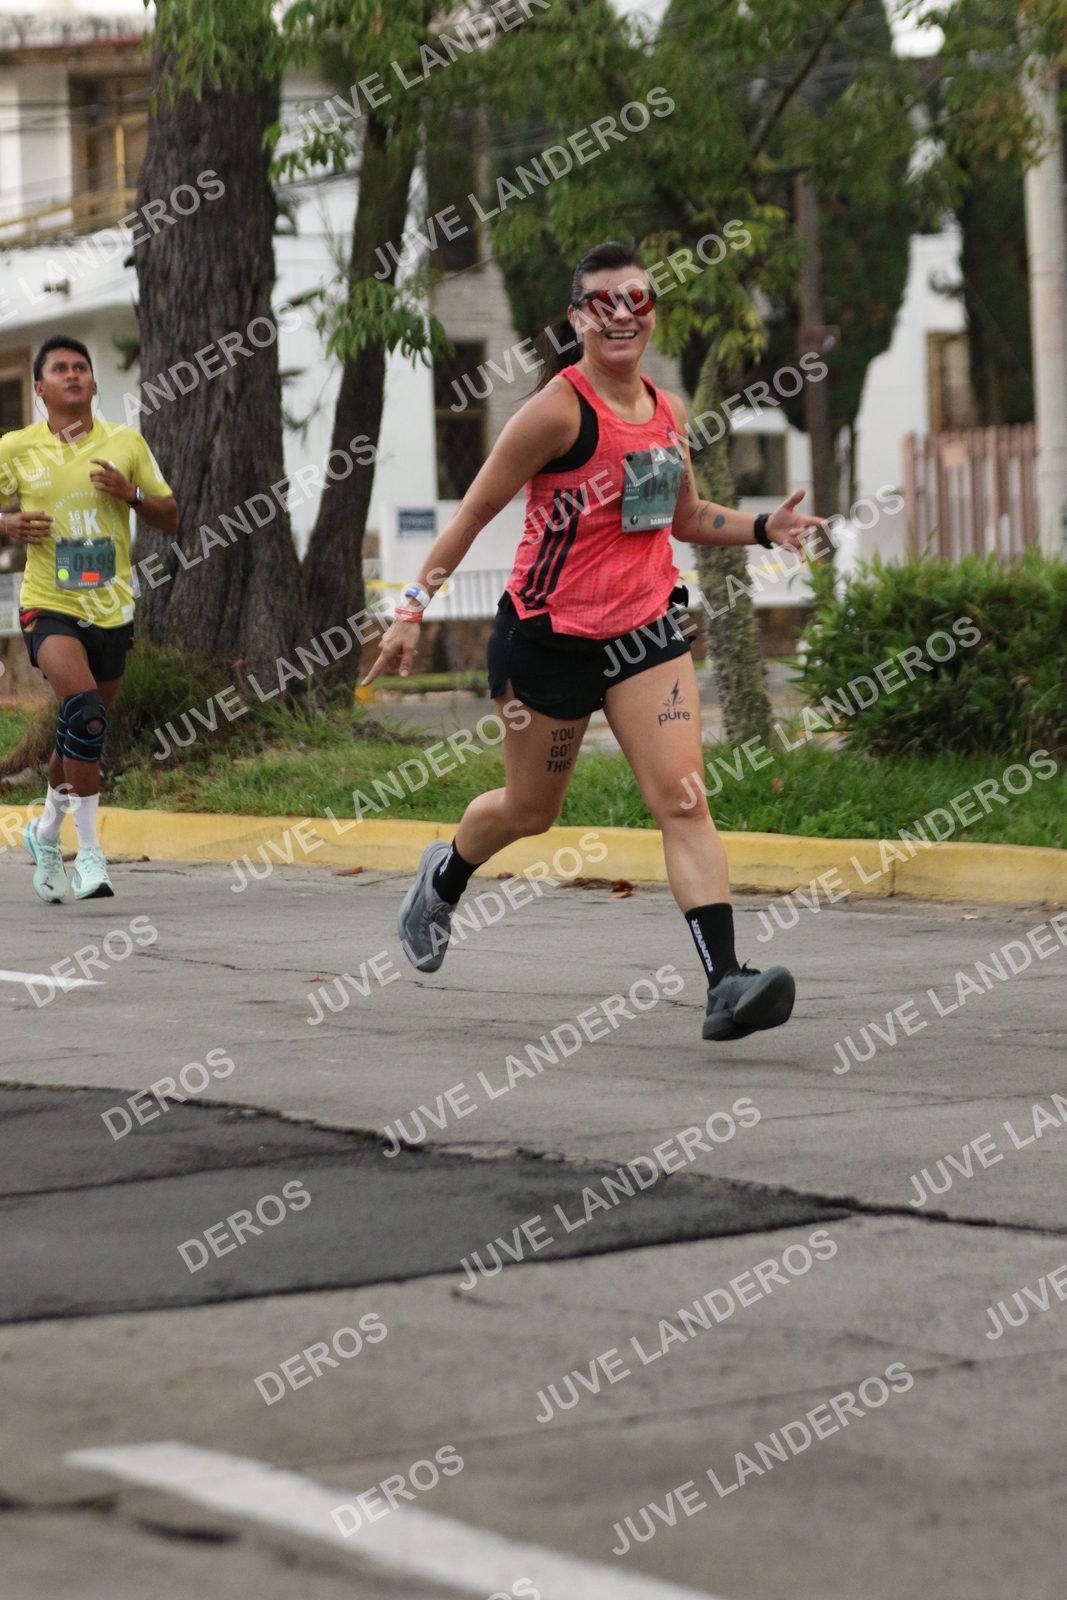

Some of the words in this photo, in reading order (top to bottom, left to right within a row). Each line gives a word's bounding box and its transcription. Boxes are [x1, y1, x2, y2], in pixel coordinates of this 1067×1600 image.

[83, 508, 101, 534] K
[551, 727, 574, 742] YOU
[550, 743, 571, 758] GO
[546, 758, 572, 773] THIS
